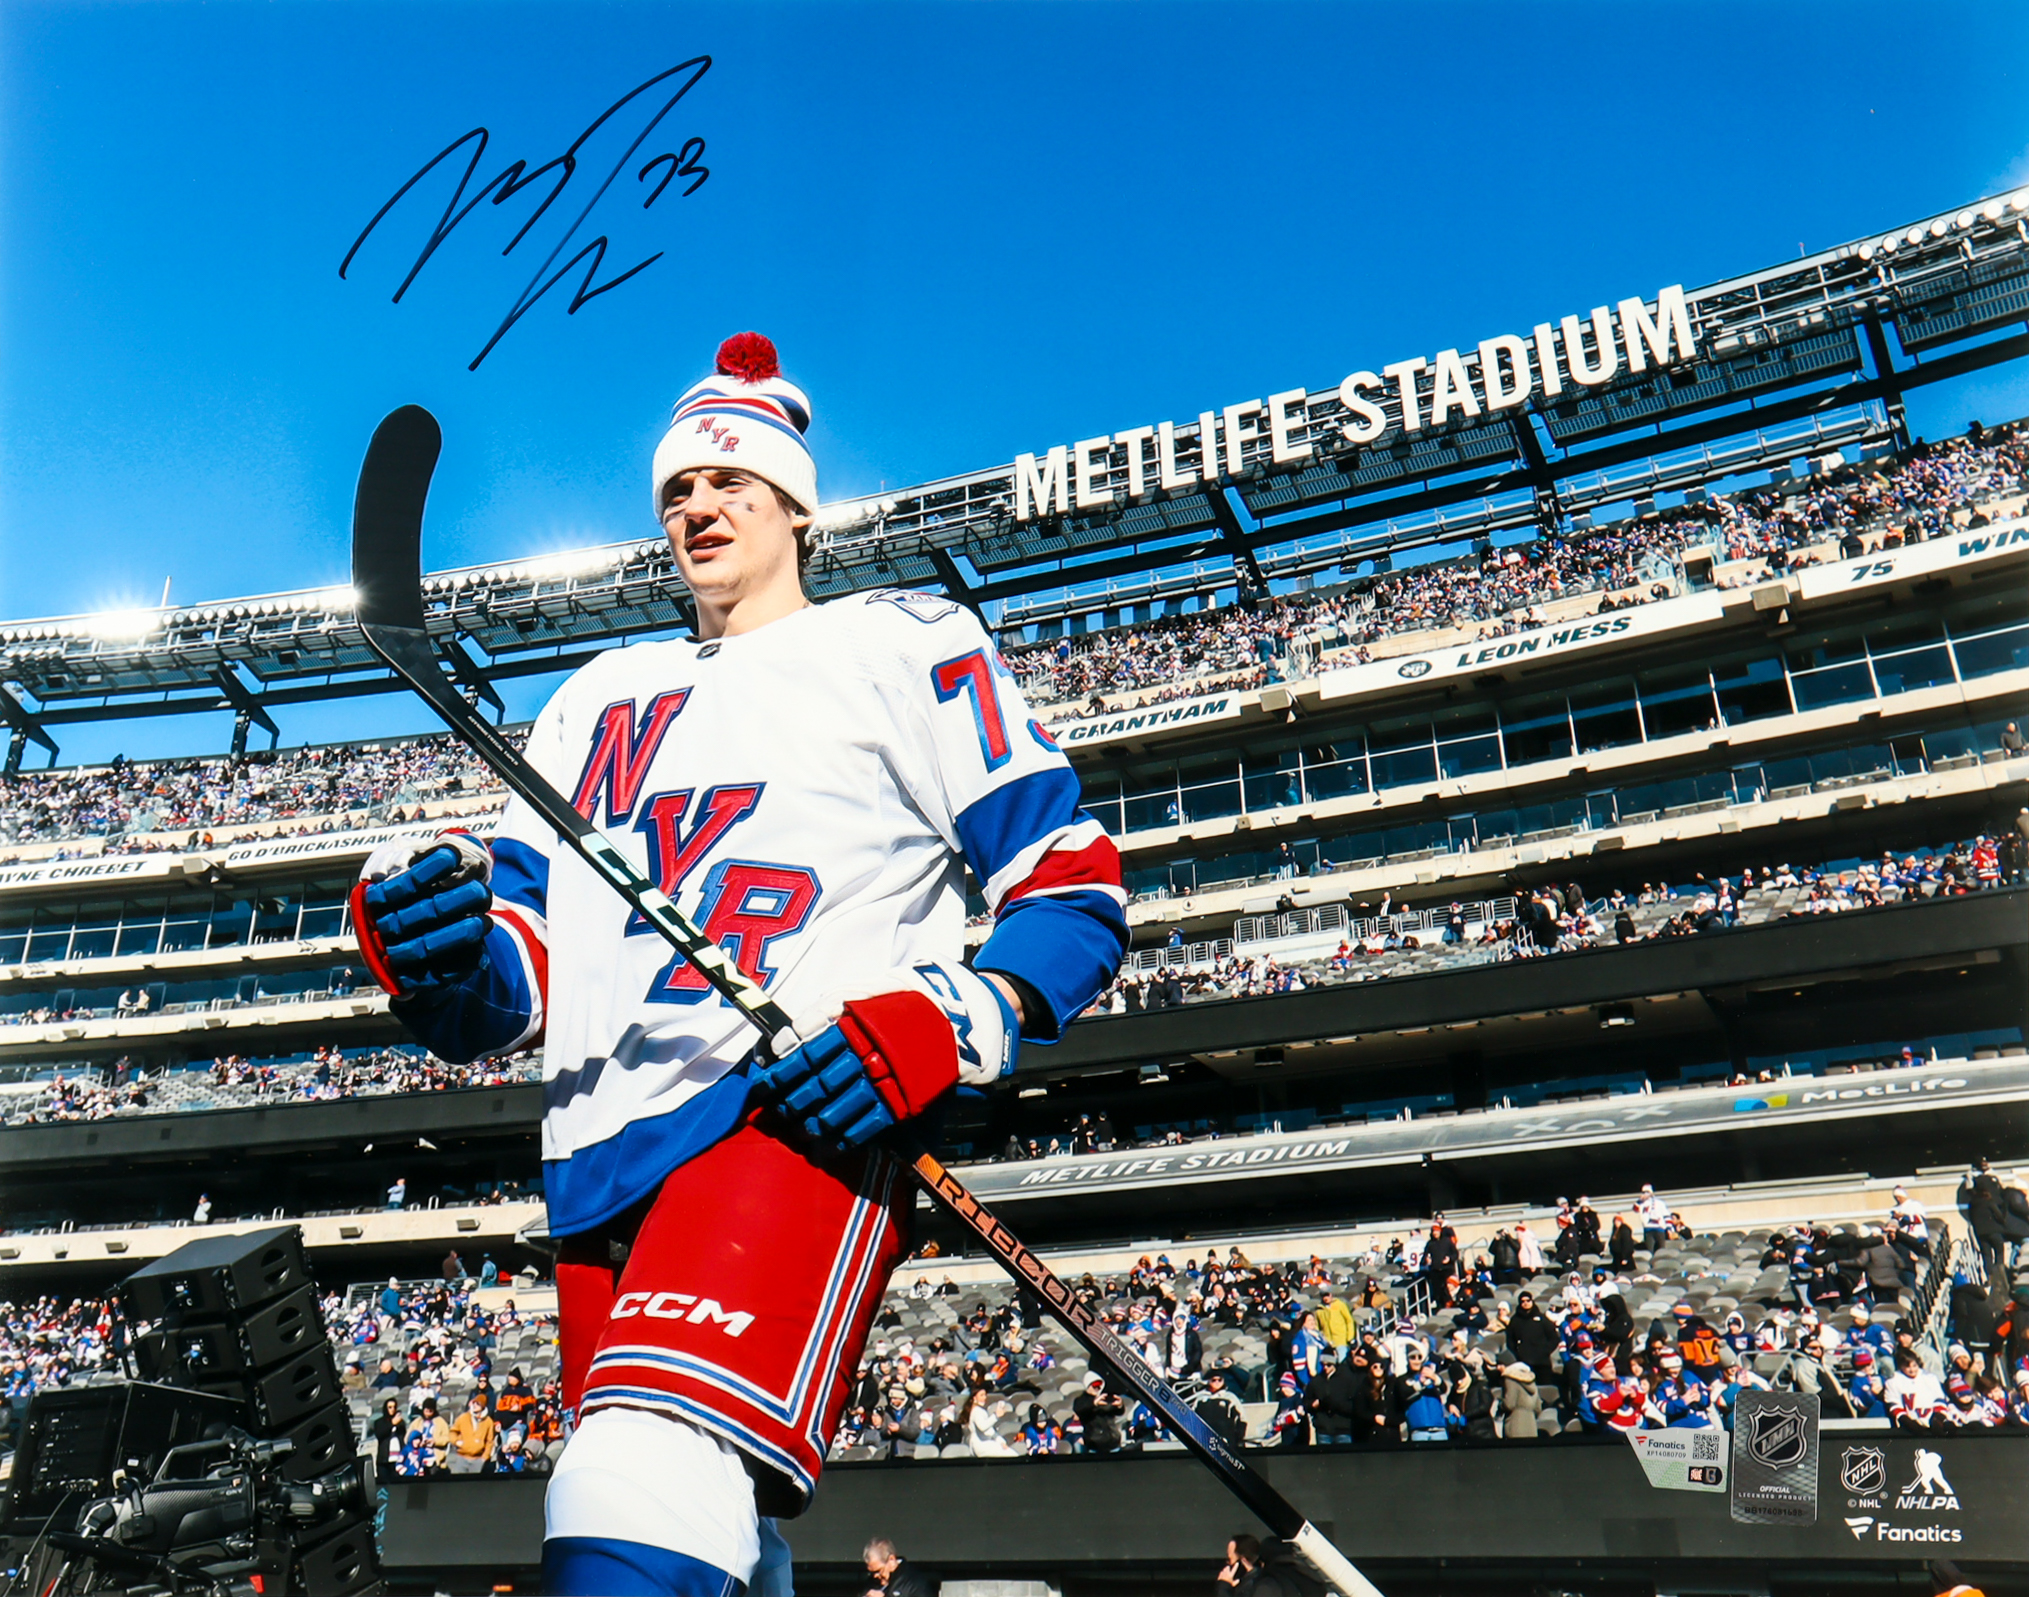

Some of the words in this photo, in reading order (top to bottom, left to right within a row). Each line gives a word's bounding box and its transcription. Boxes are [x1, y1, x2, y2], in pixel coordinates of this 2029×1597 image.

[1015, 387, 1313, 522] METLIFE
[1339, 283, 1697, 443] STADIUM
[695, 416, 740, 452] NYR
[1851, 559, 1894, 582] 75
[1457, 637, 1541, 668] LEON
[1547, 616, 1632, 648] HESS
[1068, 697, 1230, 741] GRANTHAM
[49, 860, 148, 880] CHREBET
[580, 830, 772, 1010] CCM
[1801, 1077, 1968, 1103] MetLife
[1019, 1156, 1176, 1186] METLIFE
[1180, 1140, 1351, 1170] STADIUM
[935, 1170, 1096, 1333] RIBCOR
[610, 1291, 756, 1338] CCM
[1101, 1329, 1160, 1392] TRIGGER
[1648, 1438, 1686, 1450] Fanatics
[1760, 1485, 1791, 1494] OFFICIAL
